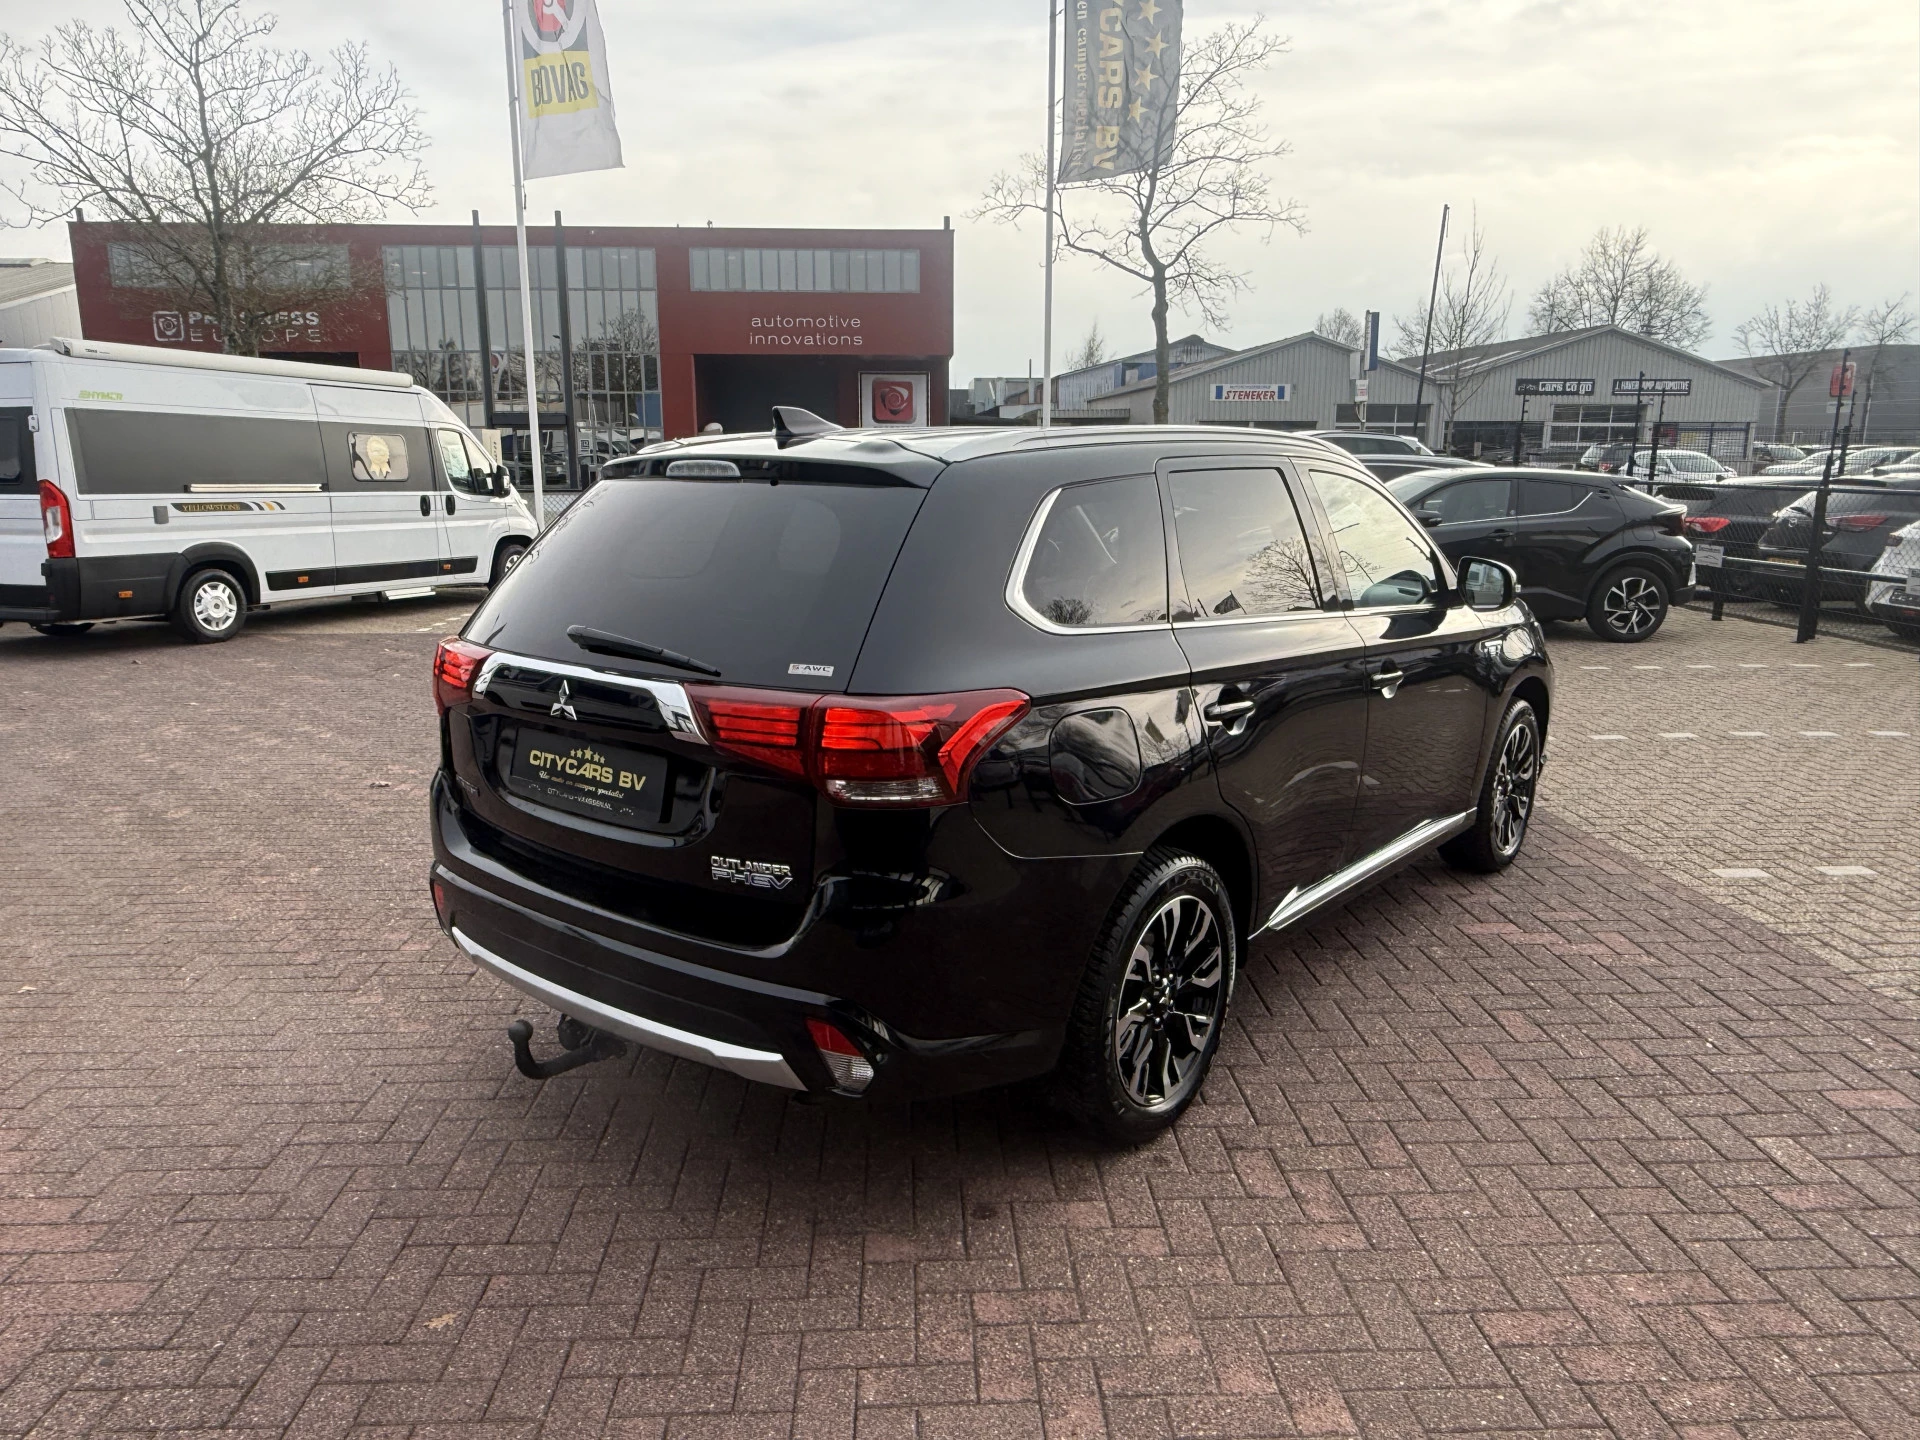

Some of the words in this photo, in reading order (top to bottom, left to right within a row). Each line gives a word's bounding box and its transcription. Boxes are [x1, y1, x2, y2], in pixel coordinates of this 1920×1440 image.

[531, 62, 589, 107] BOVAG
[1093, 125, 1121, 170] BV
[751, 315, 861, 328] automotive
[190, 328, 321, 343] EUOPE
[749, 332, 863, 345] innovations
[1224, 390, 1276, 400] STENEKER
[182, 504, 241, 512] YELLOWSTONE
[529, 750, 613, 783] CITYCARS
[618, 771, 647, 791] BV
[711, 856, 792, 876] OUTLANDER
[712, 867, 793, 889] PHEV
